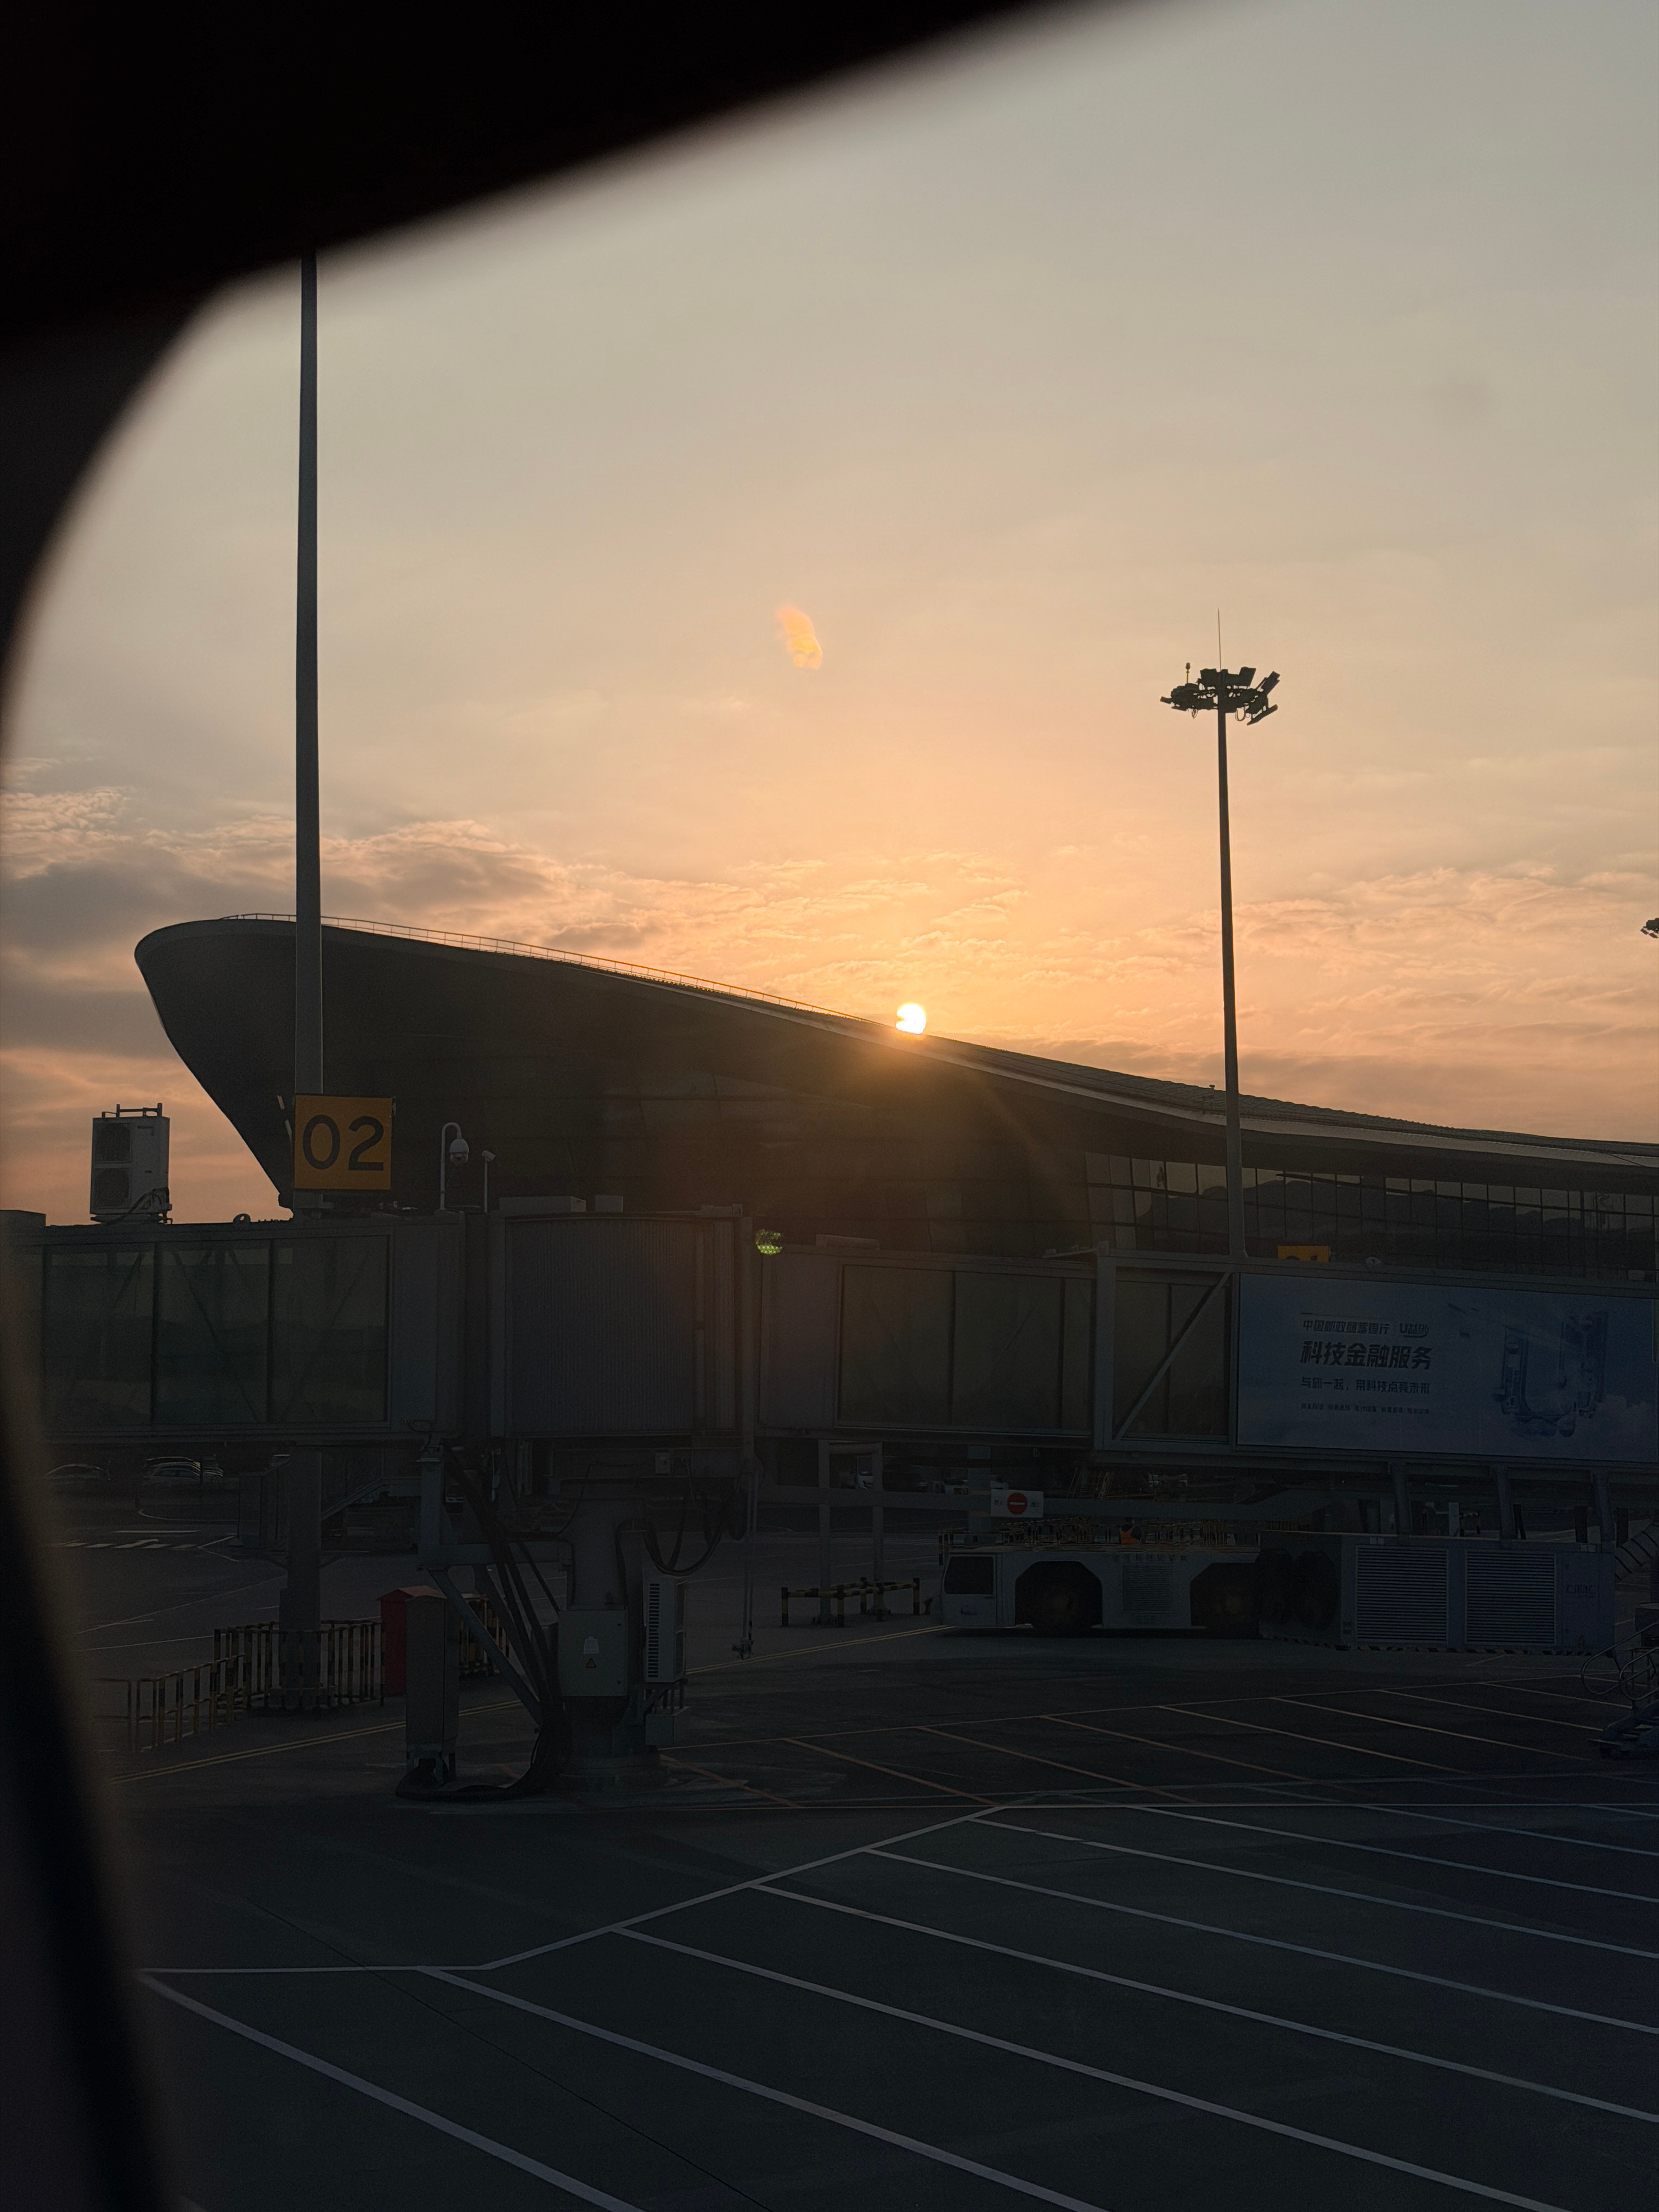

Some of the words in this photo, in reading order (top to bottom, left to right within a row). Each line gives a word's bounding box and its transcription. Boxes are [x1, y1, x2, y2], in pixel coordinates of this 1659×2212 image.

[303, 1114, 384, 1170] 02
[1300, 1340, 1433, 1370] 科技金融服务
